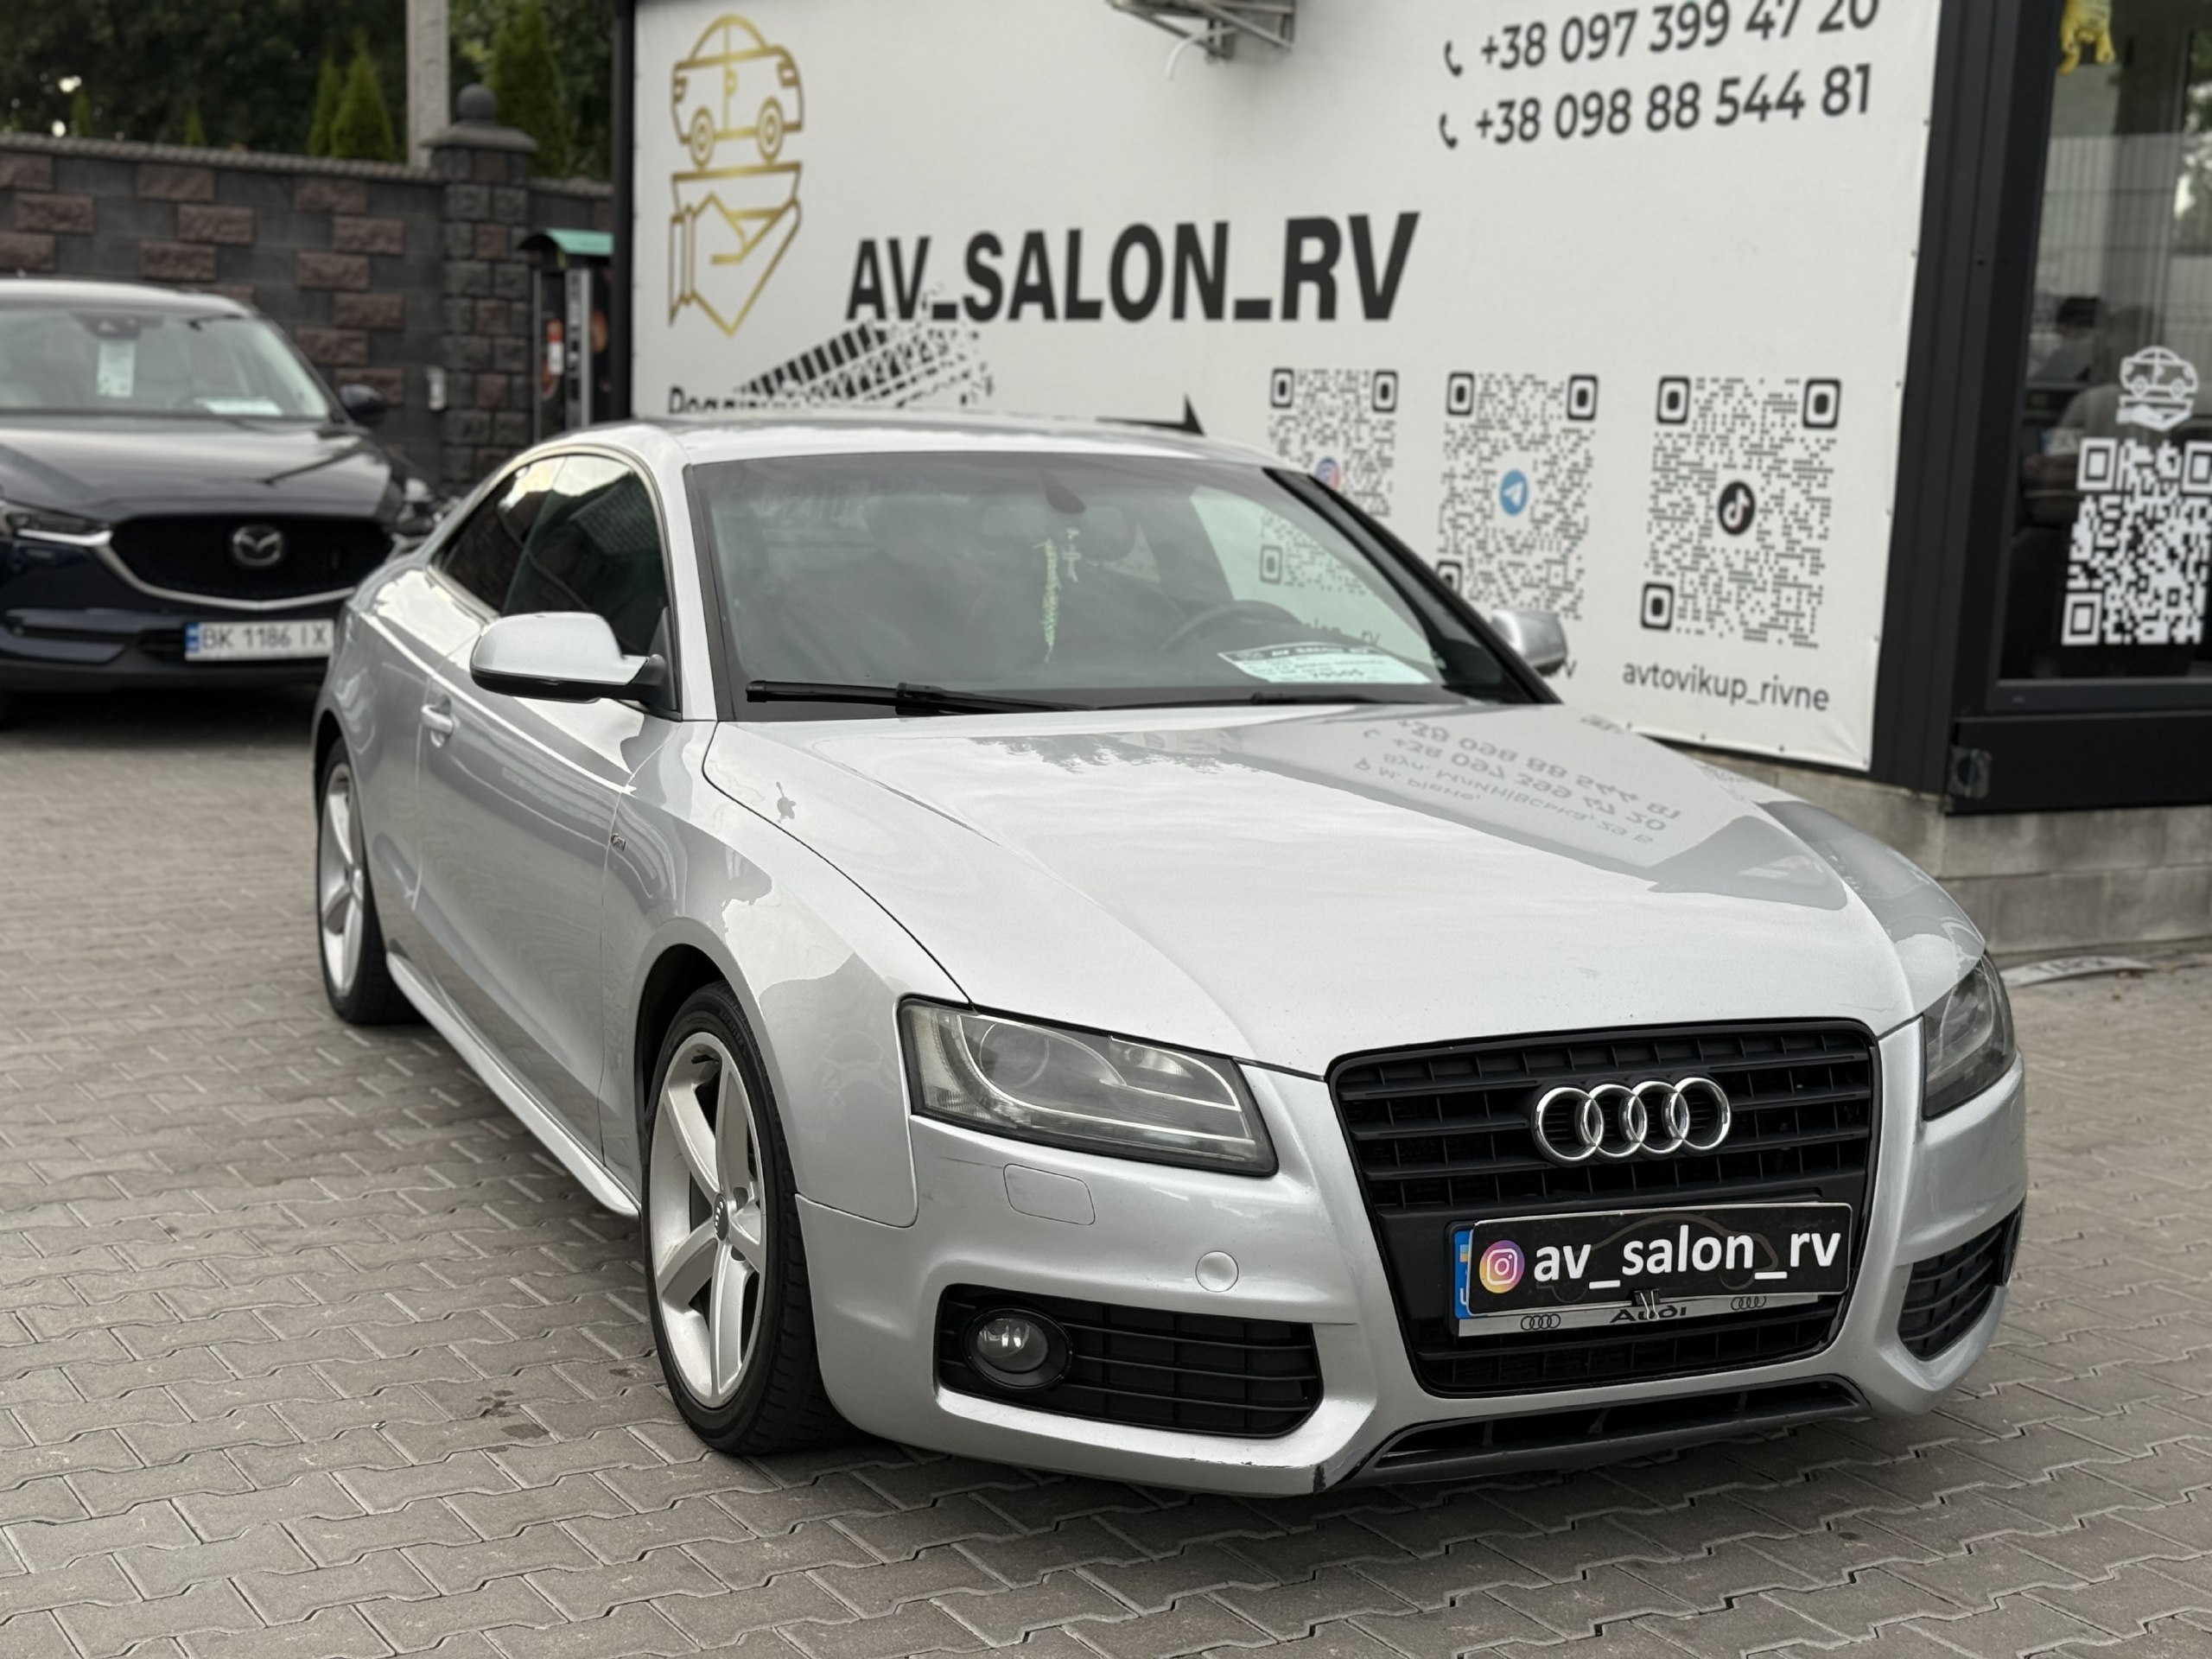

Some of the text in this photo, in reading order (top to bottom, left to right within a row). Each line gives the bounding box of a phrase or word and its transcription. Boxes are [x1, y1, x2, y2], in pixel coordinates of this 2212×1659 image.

[1481, 22, 1547, 70] +38
[1560, 10, 1637, 63] 097
[1649, 2, 1728, 53] 399
[1745, 0, 1802, 40] 47
[1475, 63, 1872, 144] +38 098 88 544 81
[846, 212, 1421, 322] AV_SALON_RV
[244, 626, 291, 647] 1186
[1623, 661, 1830, 711] avtovikup_rivne
[1533, 1224, 1841, 1290] av_salon_rv
